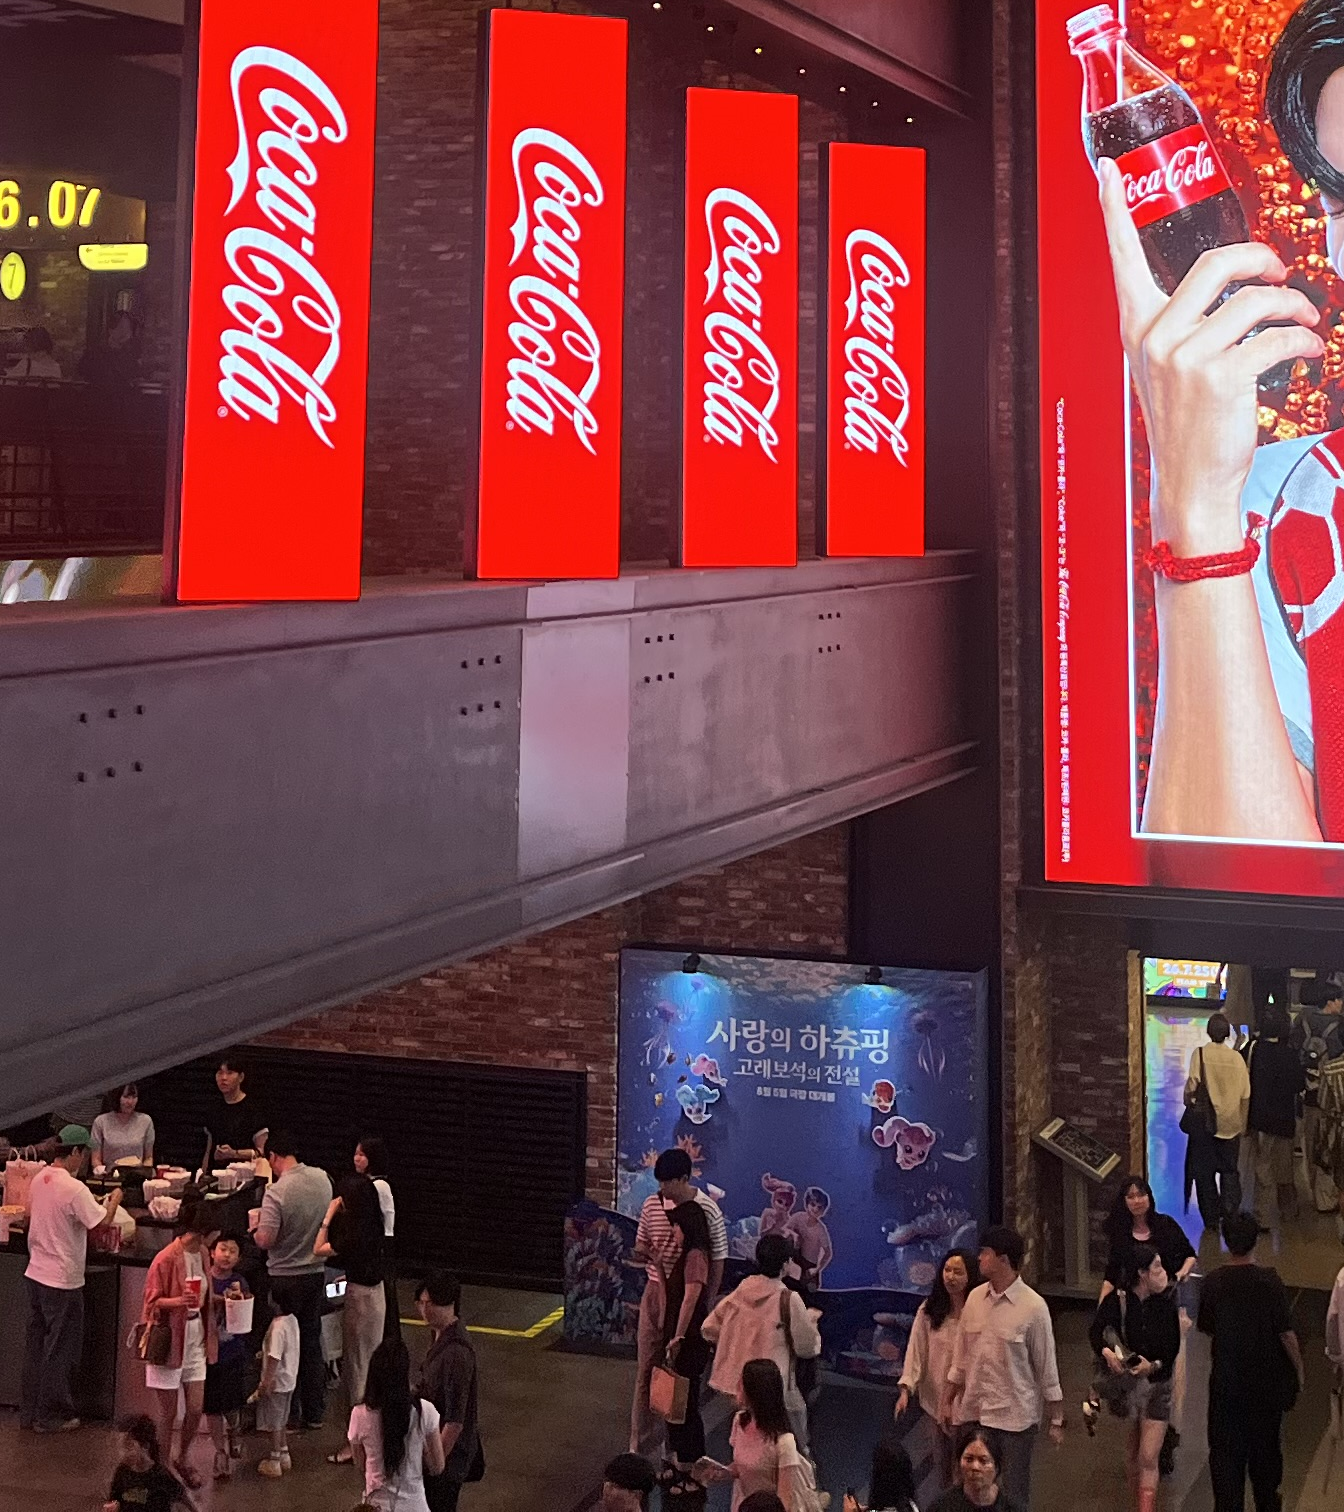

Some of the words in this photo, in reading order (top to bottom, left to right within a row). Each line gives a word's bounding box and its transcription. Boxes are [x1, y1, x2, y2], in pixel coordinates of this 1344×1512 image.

[218, 46, 348, 448] Coca-Cola
[506, 127, 603, 455] Coca-Cola
[703, 187, 780, 463] Coca-Cola
[844, 229, 910, 468] Coca-Cola
[706, 1017, 791, 1055] 사랑의
[798, 1024, 890, 1065] 하츄핑
[733, 1058, 821, 1084] 고래보석의
[824, 1064, 861, 1087] 전설
